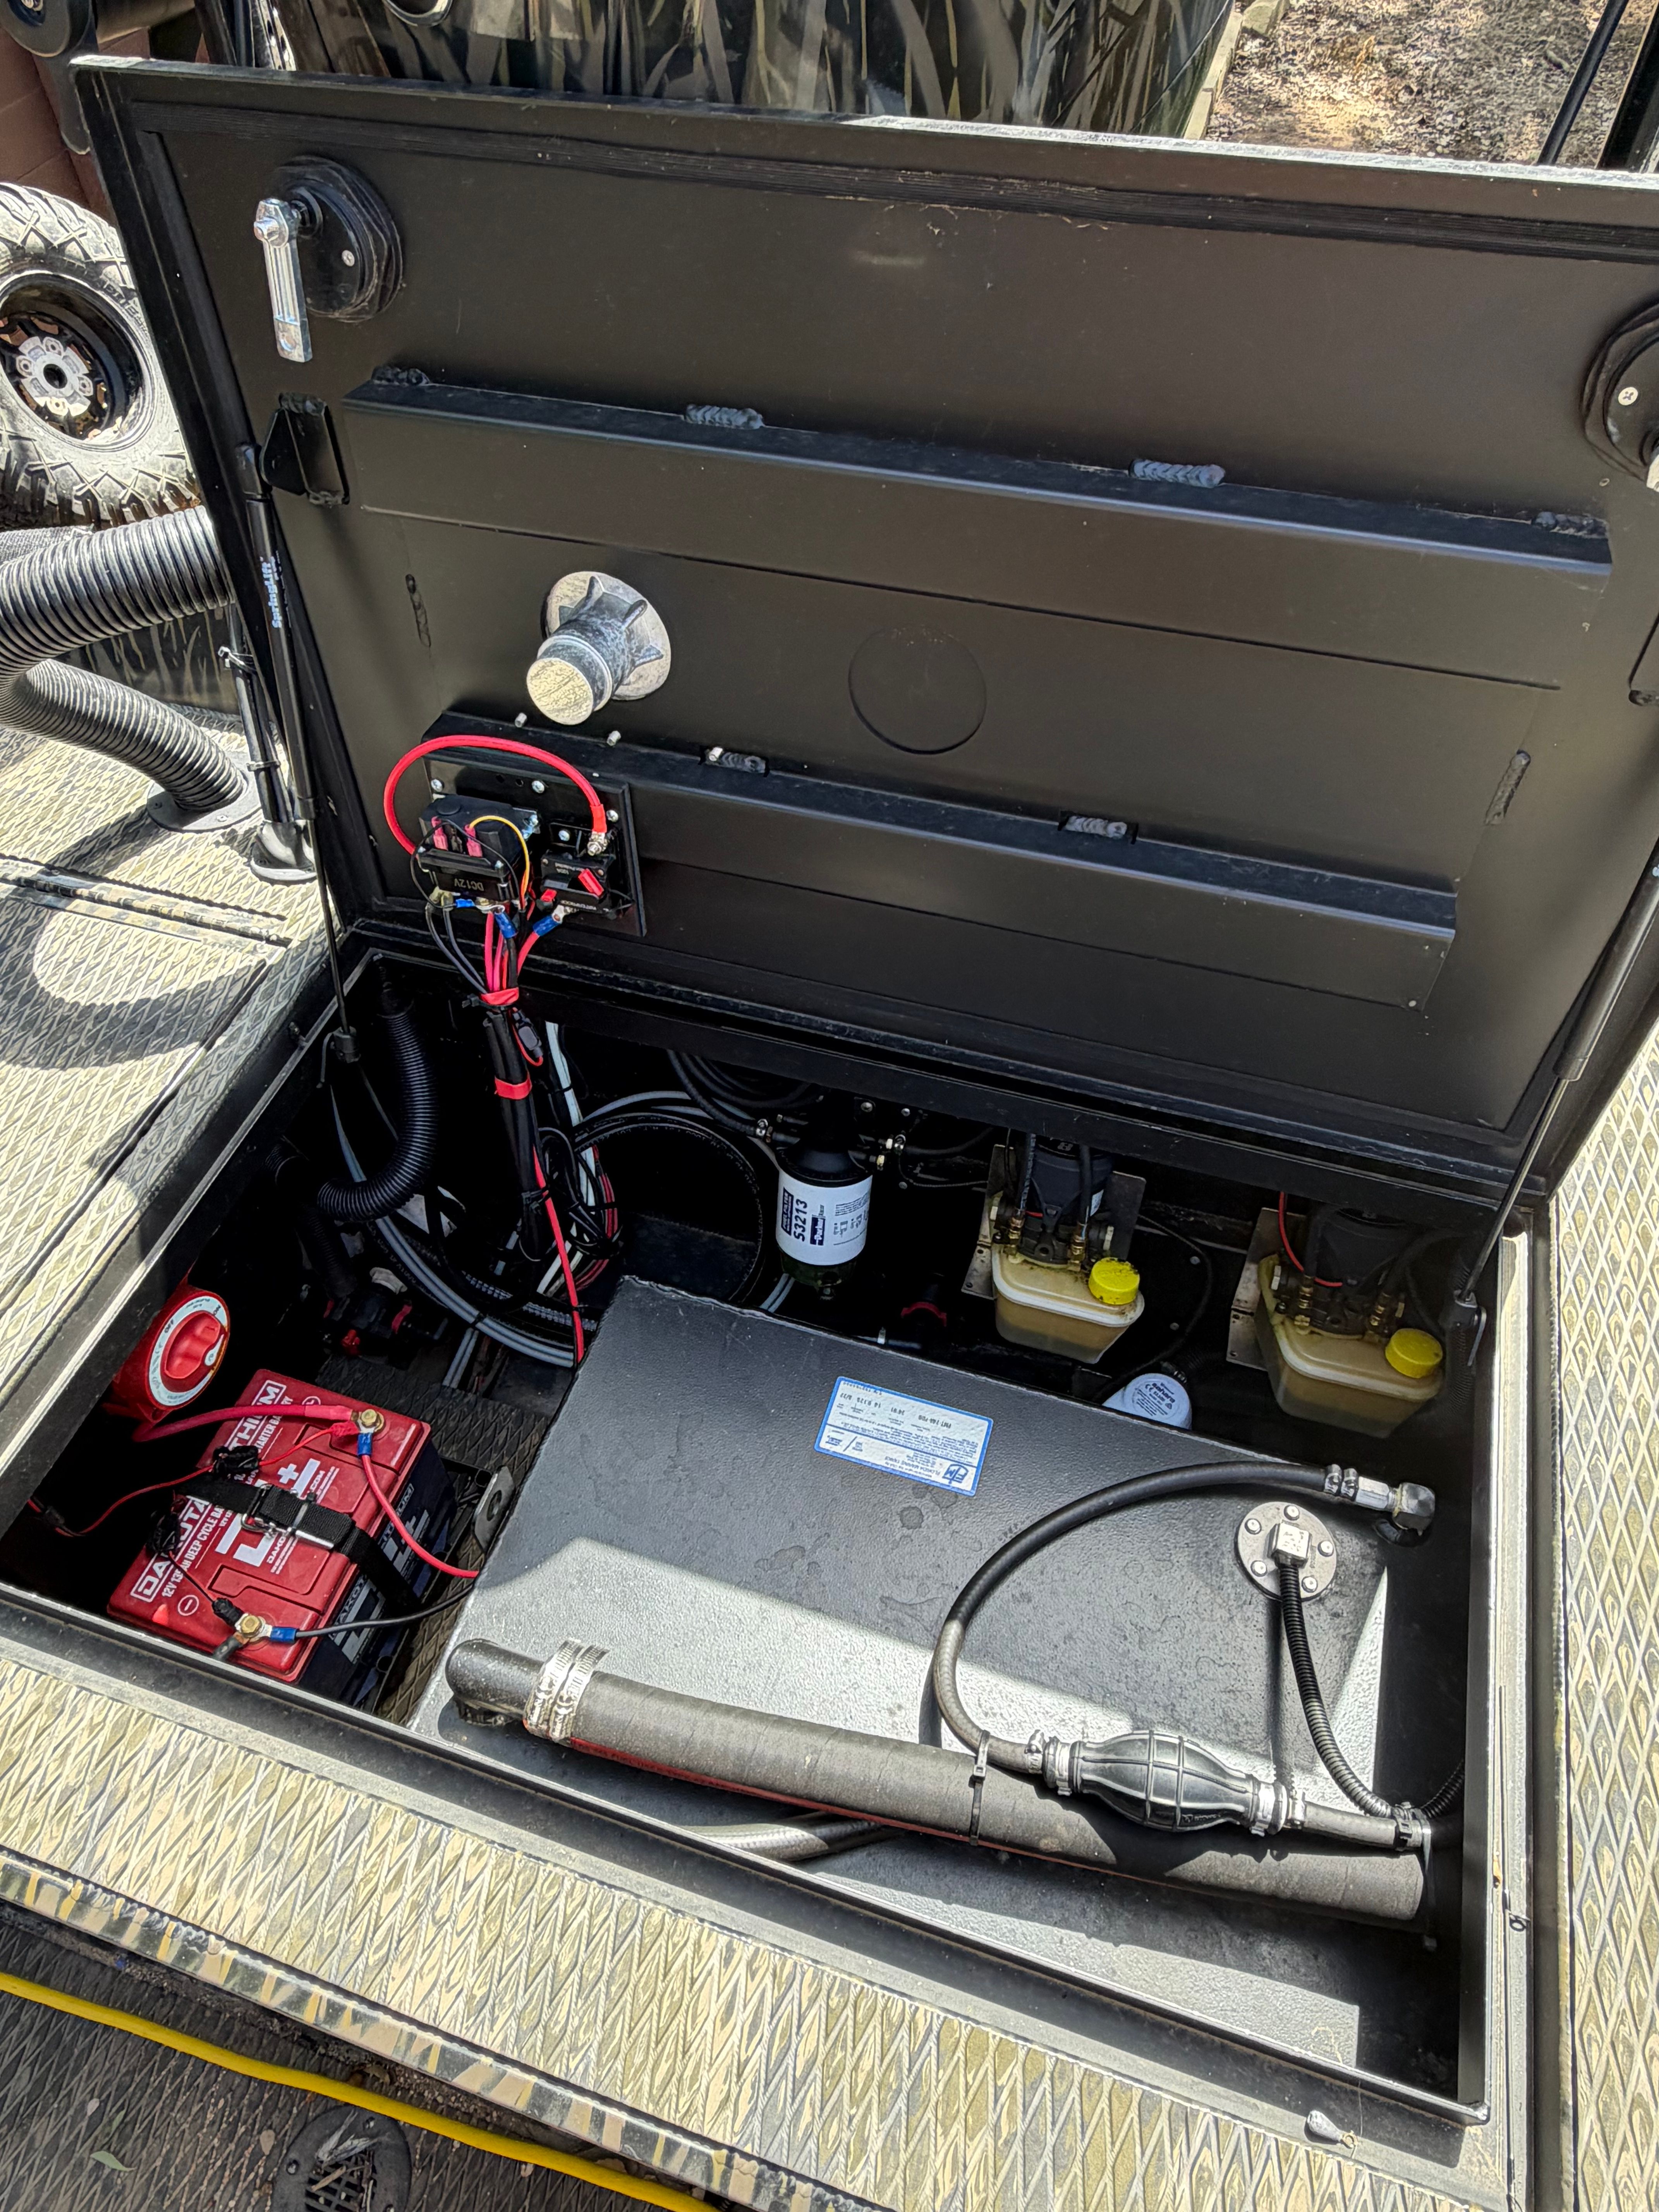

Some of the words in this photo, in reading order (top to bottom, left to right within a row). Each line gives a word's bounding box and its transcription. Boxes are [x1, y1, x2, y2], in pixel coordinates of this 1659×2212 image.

[454, 878, 483, 891] DC12V
[793, 1198, 807, 1242] S3213
[814, 1218, 823, 1240] Parker
[164, 1319, 174, 1333] OFF
[161, 1581, 177, 1598] 12V
[184, 1539, 204, 1561] DEEP
[196, 1516, 218, 1541] CYCLE
